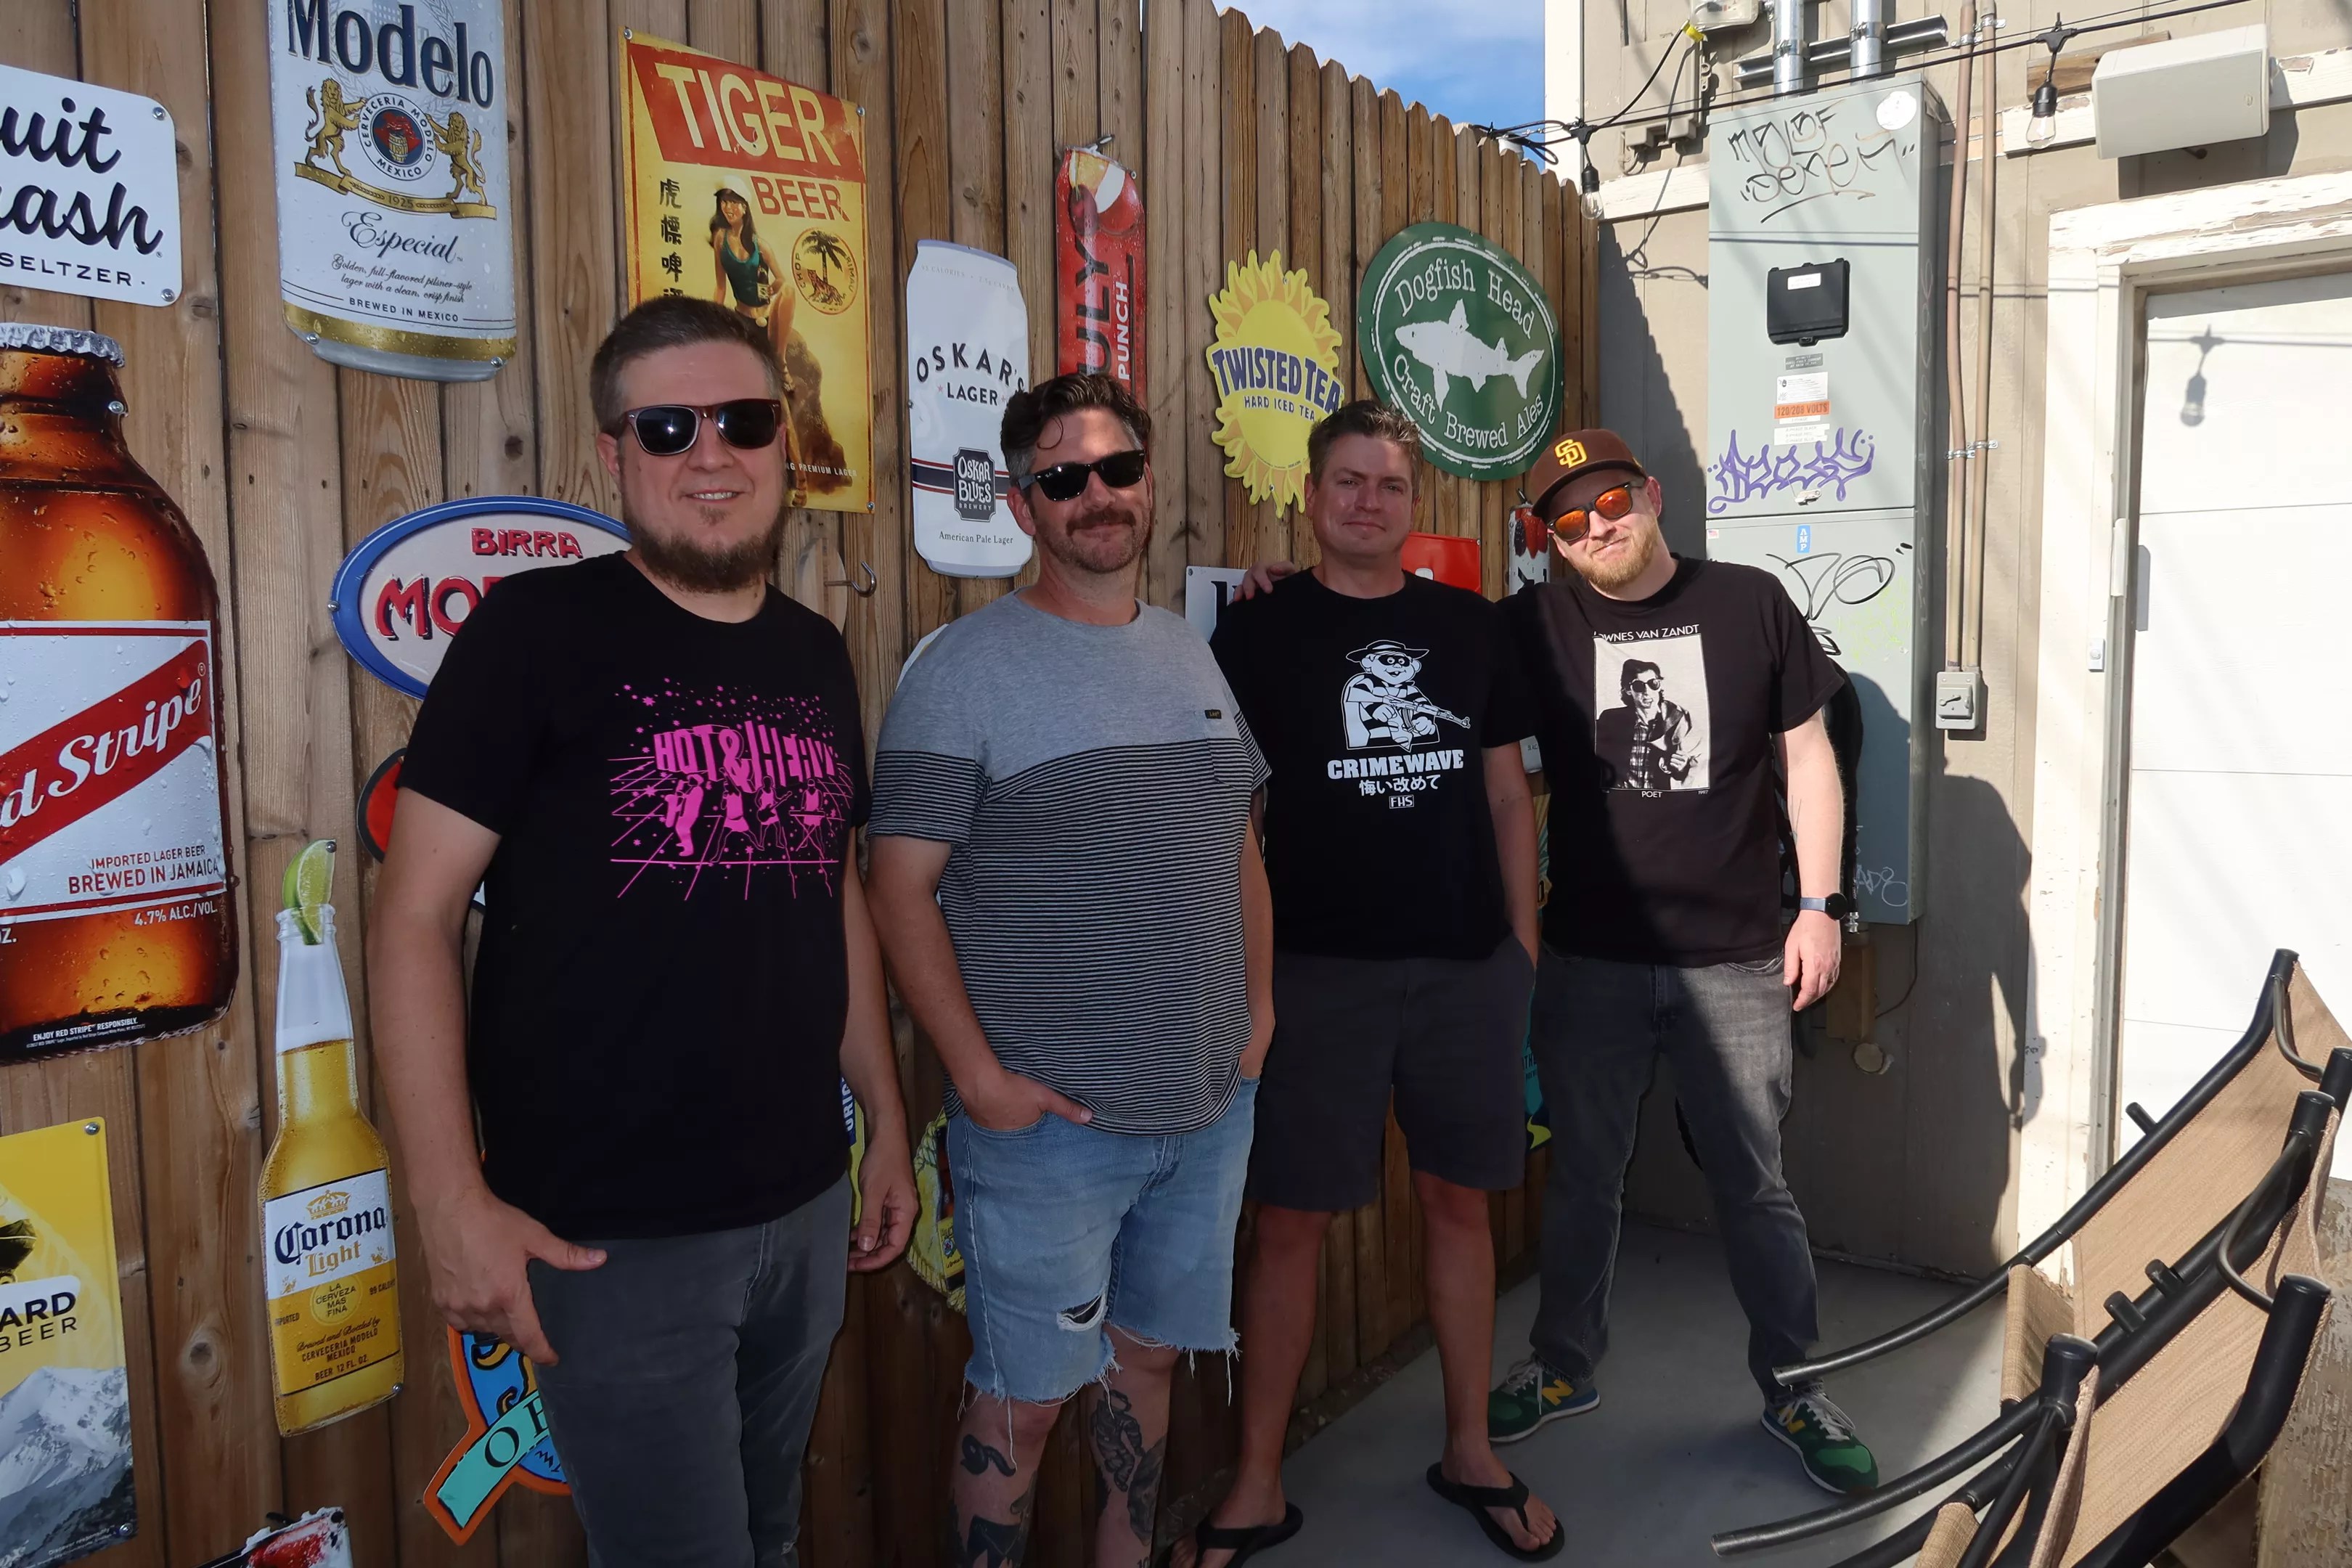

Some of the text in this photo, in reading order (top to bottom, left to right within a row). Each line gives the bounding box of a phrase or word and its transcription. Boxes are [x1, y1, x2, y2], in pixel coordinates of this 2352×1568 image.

[287, 0, 494, 108] Modelo
[654, 62, 841, 166] TIGER
[362, 96, 434, 163] CERVECERIA MODELO
[377, 157, 422, 178] MEXICO
[388, 194, 415, 208] 1925
[750, 176, 850, 221] BEER
[0, 181, 163, 255] ash
[341, 211, 458, 264] Especial
[332, 253, 473, 294] Golden, full-flavored pilsner-style
[341, 274, 363, 290] lager
[365, 280, 383, 291] with
[394, 285, 420, 298] clean,
[423, 291, 444, 305] crisp
[442, 291, 465, 304] finish
[1395, 258, 1535, 339] Dogfish Head
[349, 297, 459, 322] BREWED IN MEXICO
[1116, 281, 1130, 380] PUNCH
[1212, 346, 1343, 415] TWISTED TEA
[947, 383, 998, 407] LAGER
[1244, 395, 1315, 422] HARD ICED TEA
[1394, 354, 1543, 449] Craft Brewed Ales
[1807, 403, 1828, 414] VOLTS
[1554, 438, 1588, 468] SD
[799, 463, 831, 474] PREMIUM
[834, 467, 857, 477] LAGER
[957, 455, 991, 481] OSKAR
[957, 479, 992, 504] BLUES
[959, 502, 992, 511] BREWERY
[470, 528, 584, 558] BIRRA
[939, 531, 1013, 547] American Pale Lager
[375, 573, 501, 641] MO
[1636, 629, 1659, 640] VAN
[1661, 624, 1699, 637] ZANDT
[48, 678, 201, 797] Stripe
[653, 724, 718, 781] HOT
[1327, 749, 1464, 780] CRIMEWAVE
[1359, 774, 1441, 796] 悔い改めて
[1390, 796, 1413, 807] FHS
[91, 844, 205, 870] IMPORTED LAGER BEER
[69, 857, 219, 894] BREWED IN JAMAICA
[134, 900, 218, 926] 4.7% ALC./VOL.
[0, 928, 17, 944] Z.
[33, 1031, 55, 1042] ENJOY
[55, 1029, 68, 1038] RED
[274, 1206, 387, 1265] Corona
[305, 1240, 361, 1277] Light
[316, 1286, 356, 1304] CERVEZA
[329, 1283, 341, 1292] LA
[327, 1297, 346, 1309] MAS
[327, 1307, 348, 1318] FINA
[297, 1317, 381, 1353] Brewed and Bottled by
[302, 1328, 378, 1362] CERVECERIA MODELO
[327, 1346, 356, 1363] MEXICO
[315, 1367, 334, 1381] BEER
[336, 1363, 345, 1373] 12
